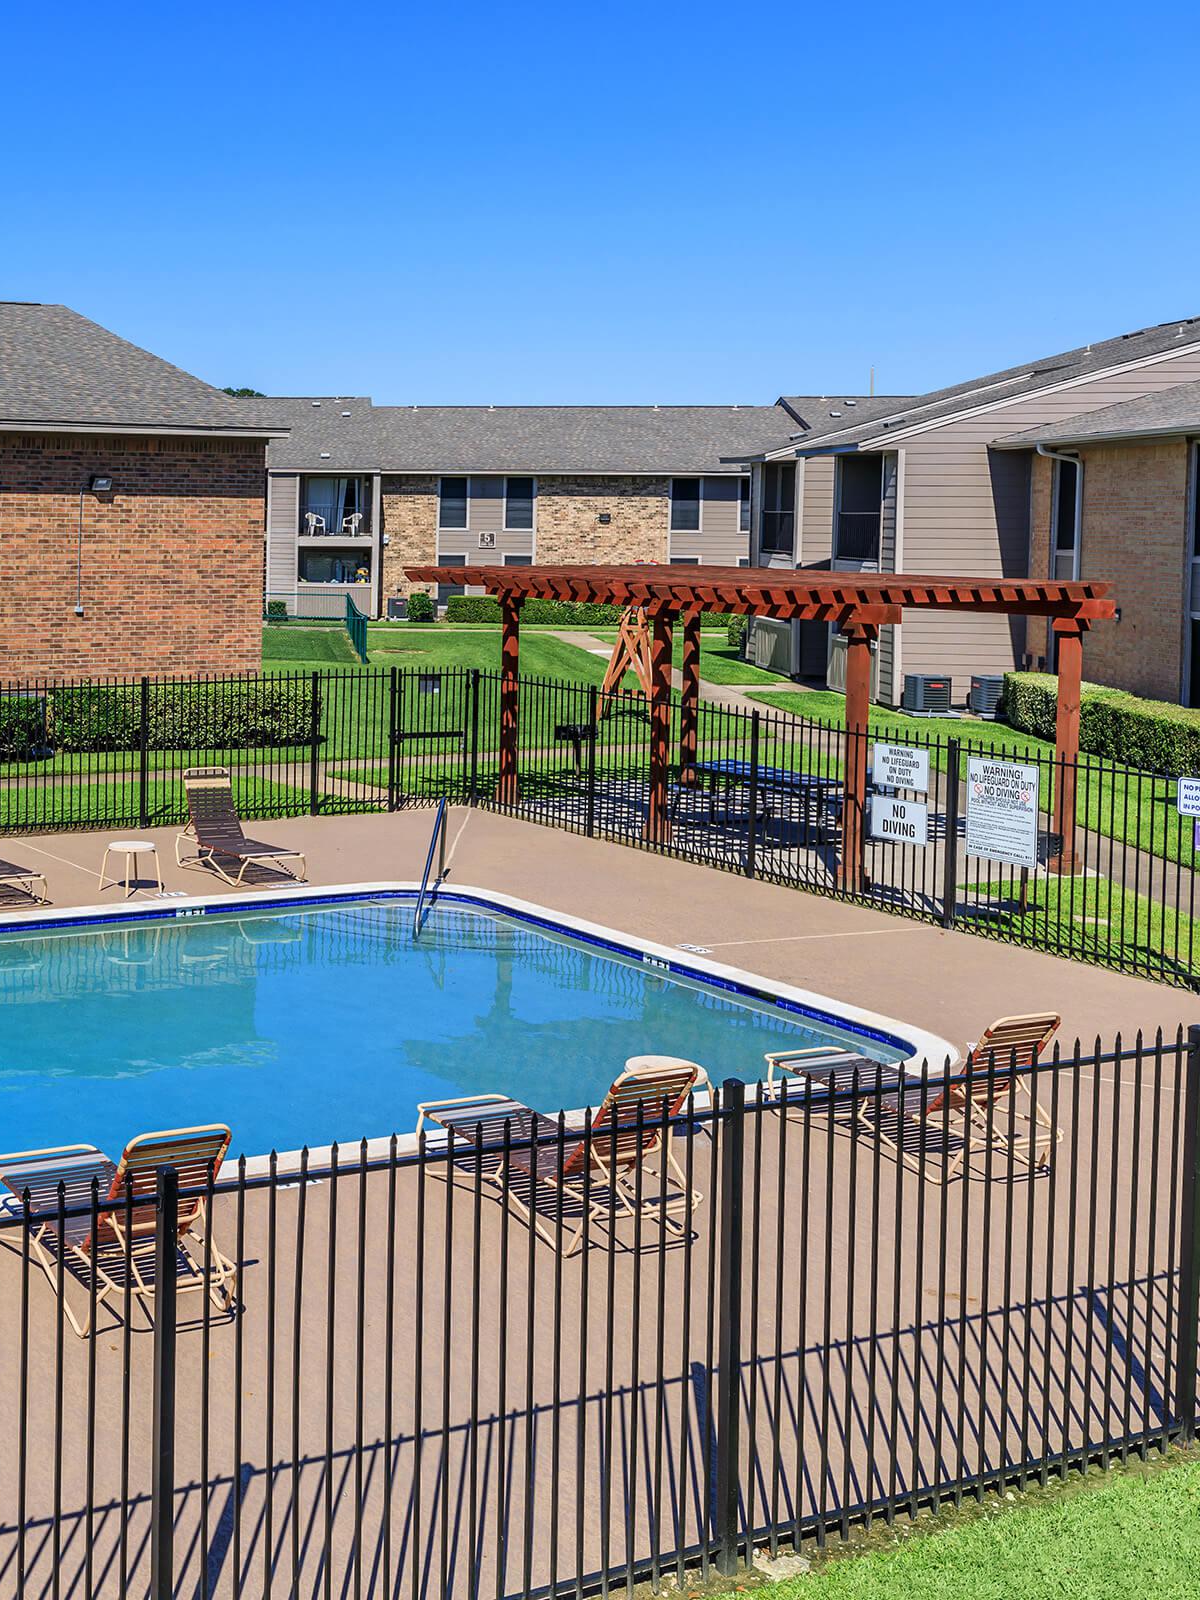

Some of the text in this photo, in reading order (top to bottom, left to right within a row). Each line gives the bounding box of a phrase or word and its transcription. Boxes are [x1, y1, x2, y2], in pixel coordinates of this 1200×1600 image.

[484, 533, 491, 543] 5
[889, 748, 914, 759] WARNING
[882, 756, 920, 769] NO LIFEGUARD
[889, 766, 912, 777] ON DUTY
[983, 765, 1023, 780] WARNING!
[886, 775, 914, 787] NO DIVING
[970, 773, 1035, 792] NO LIFEGUARD ON DUTY
[984, 786, 1019, 800] NO DIVING
[892, 804, 906, 819] NO
[882, 819, 915, 838] DIVING
